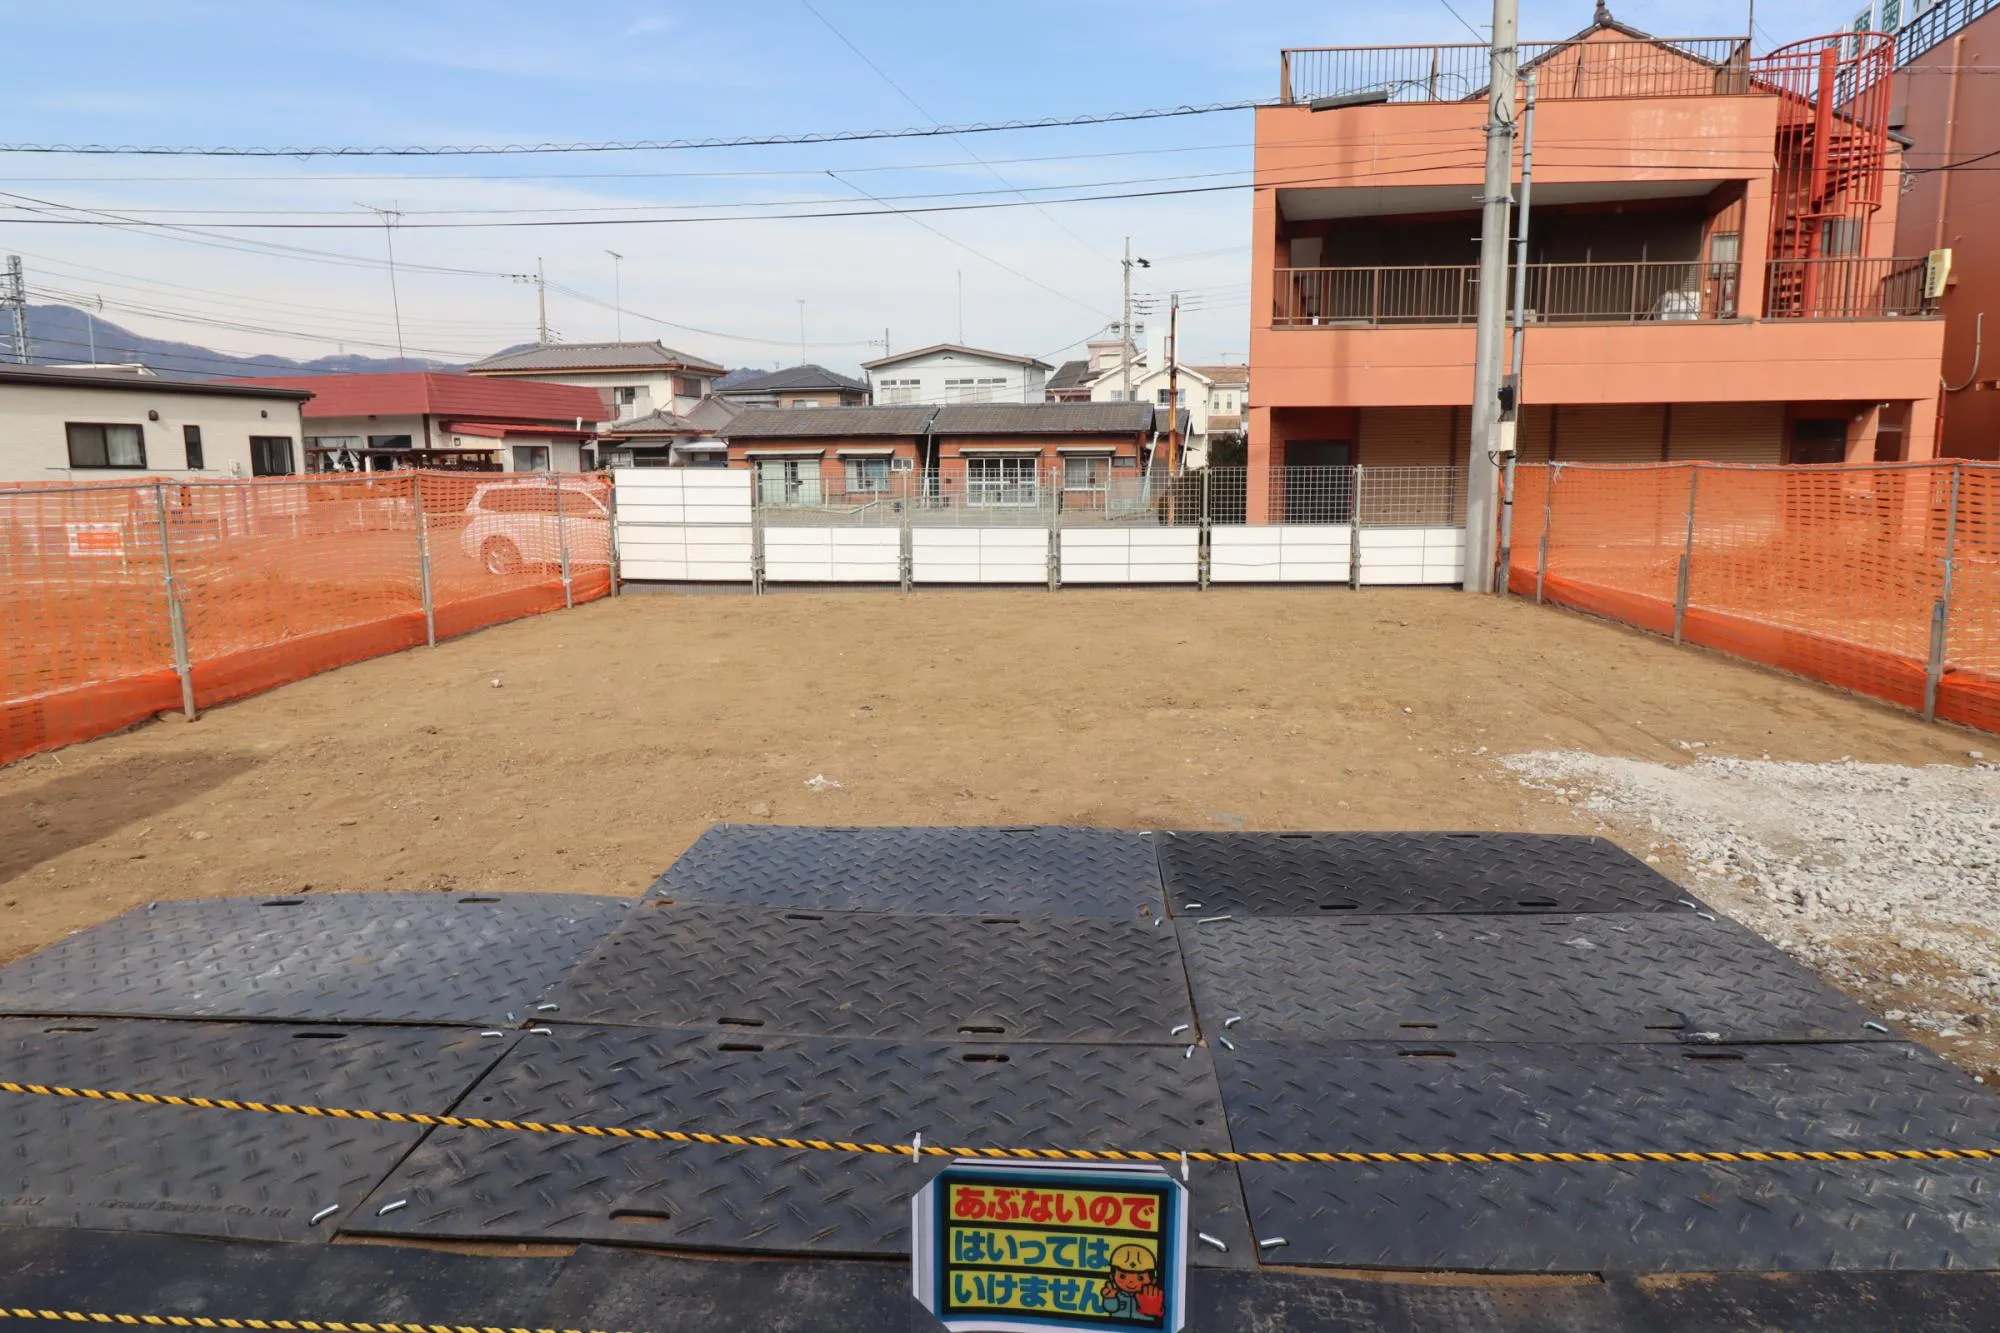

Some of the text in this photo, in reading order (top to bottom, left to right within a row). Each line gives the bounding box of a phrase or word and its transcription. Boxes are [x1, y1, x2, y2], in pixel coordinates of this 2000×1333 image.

[955, 1187, 1155, 1230] あぶないので
[955, 1230, 1110, 1270] はいっては
[955, 1273, 1105, 1314] いけません
